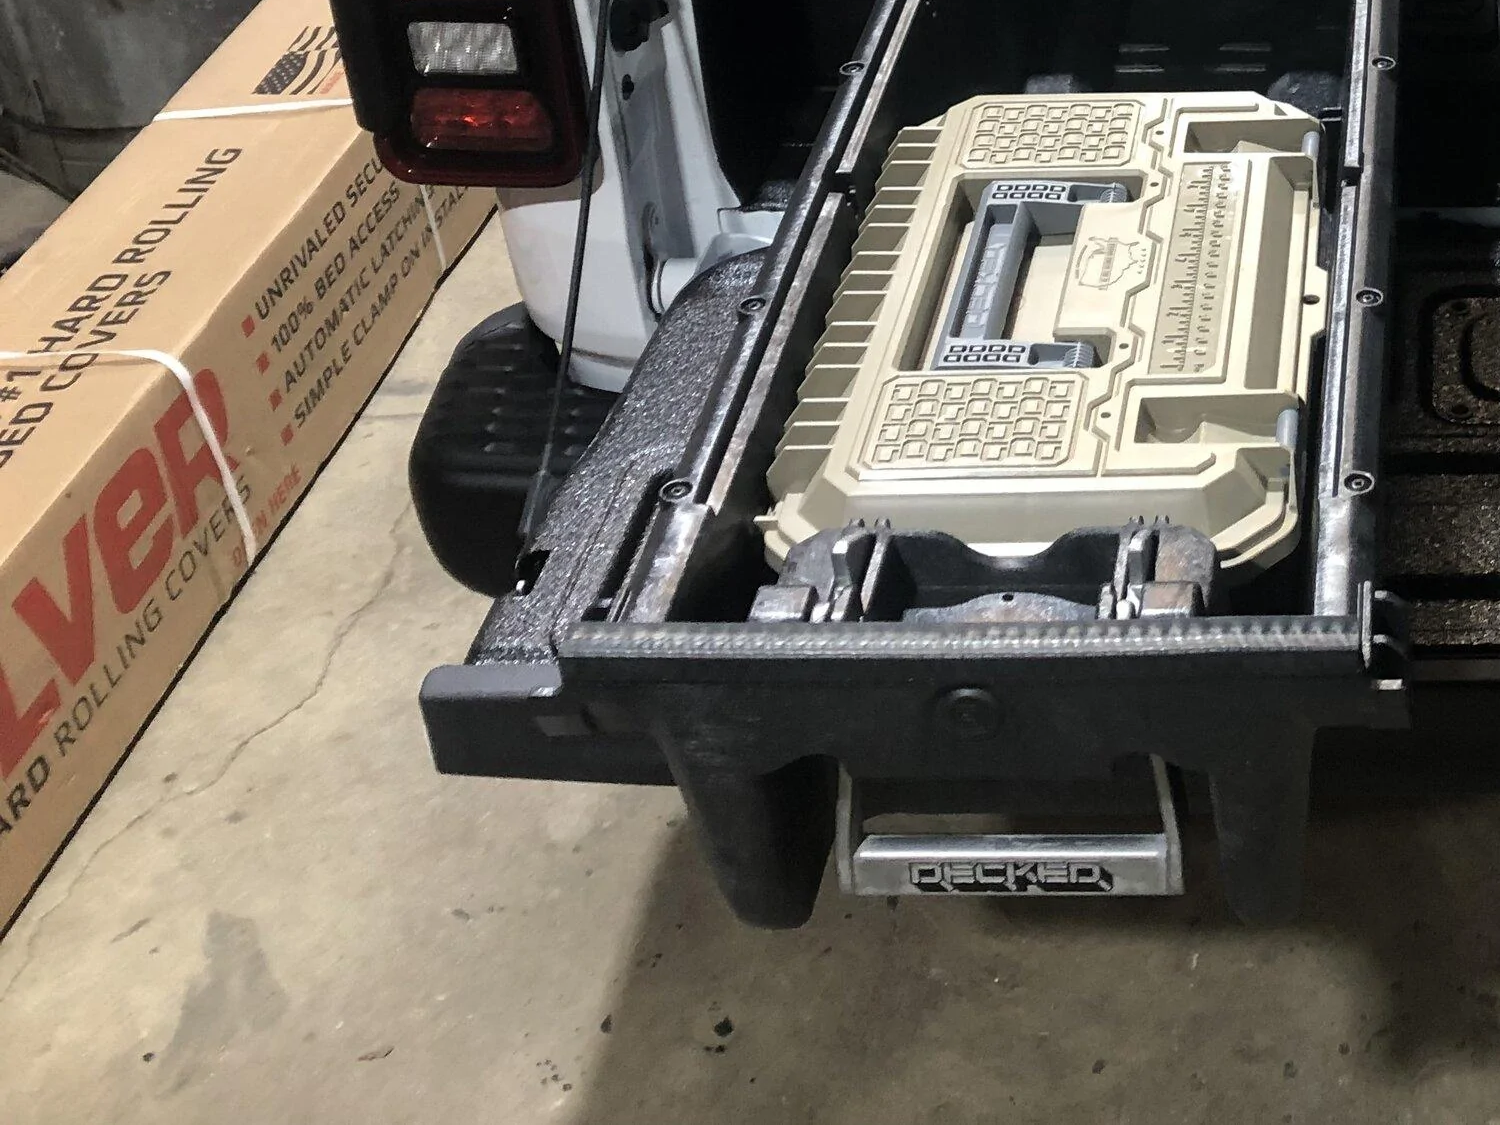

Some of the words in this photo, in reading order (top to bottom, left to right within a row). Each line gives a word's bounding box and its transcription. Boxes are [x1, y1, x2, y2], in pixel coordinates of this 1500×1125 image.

[27, 273, 129, 354] HARD
[112, 147, 243, 265] ROLLING
[254, 200, 346, 321] UNRIVALED
[270, 296, 314, 354] 100%
[313, 252, 346, 301] BED
[349, 180, 401, 261] ACCESS
[39, 269, 172, 392] COVERS
[282, 267, 370, 393] AUTOMATIC
[293, 342, 353, 428] SIMPLE
[352, 273, 399, 347] CLAMP
[400, 241, 421, 279] ON
[53, 598, 163, 757] ROLLING
[164, 475, 251, 602] COVERS
[908, 861, 1114, 893] DECKED
